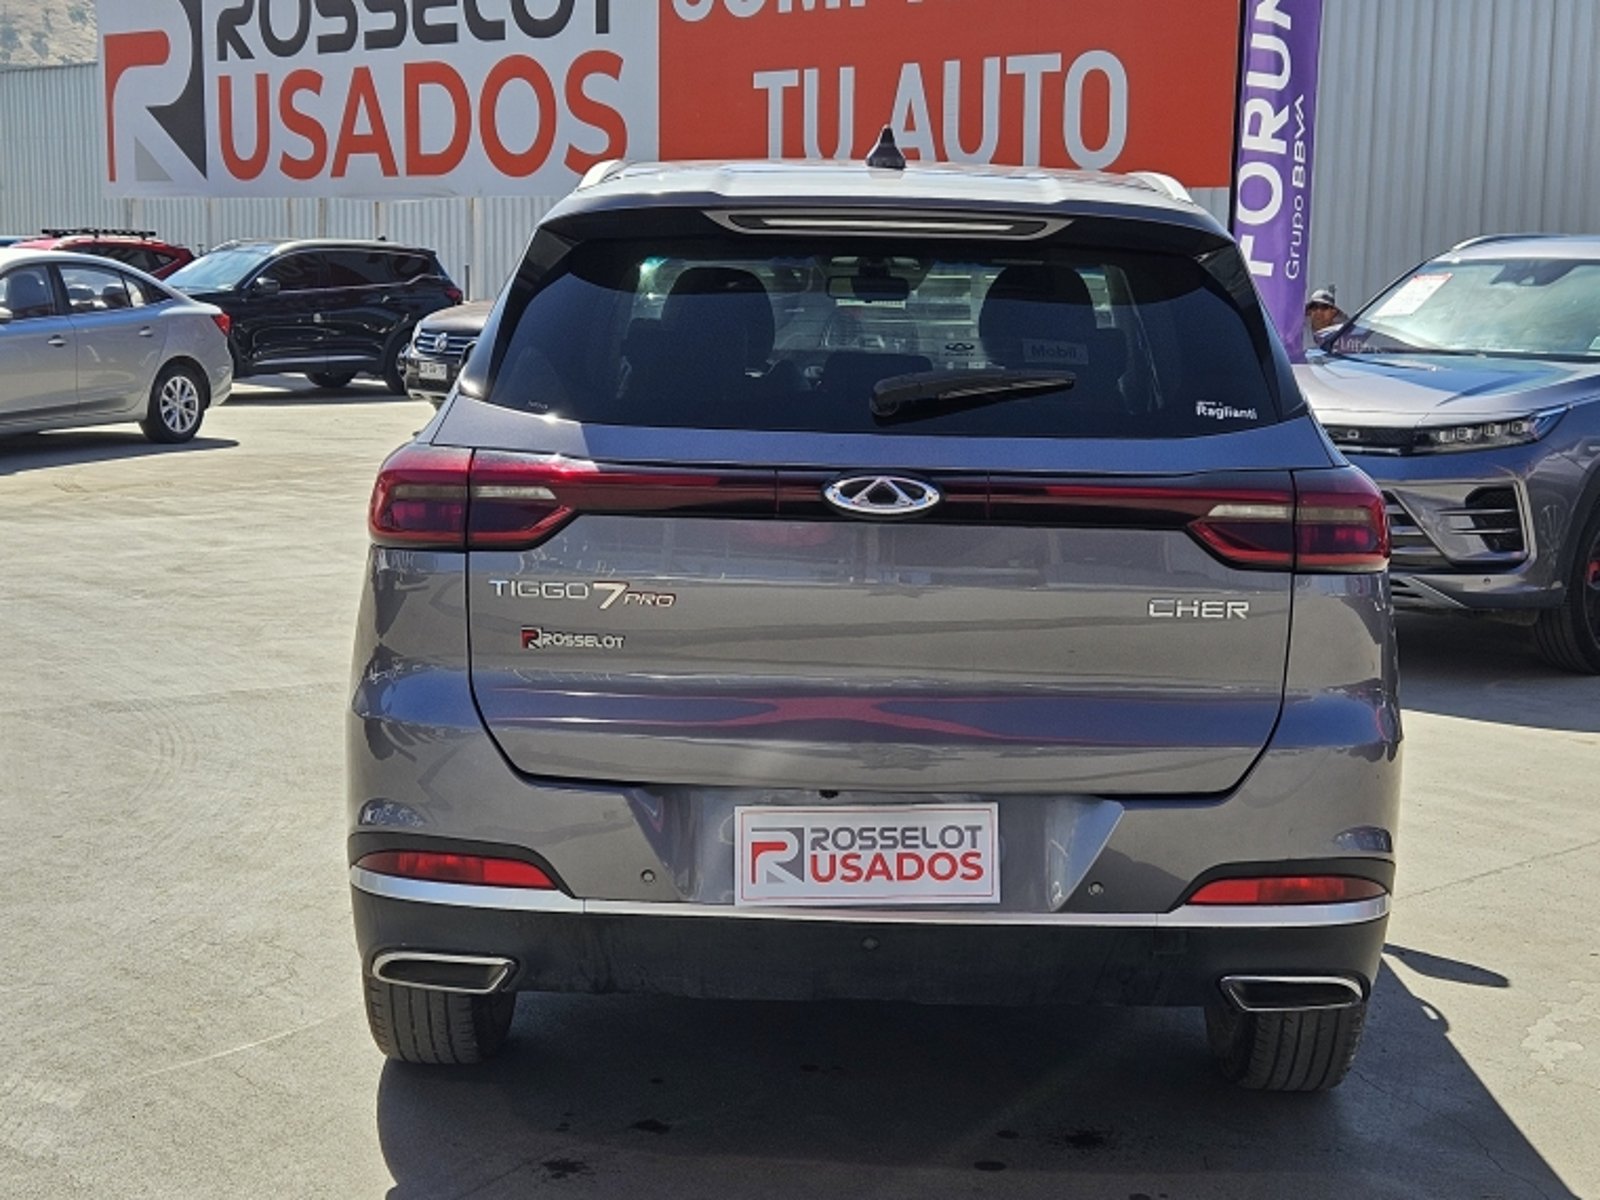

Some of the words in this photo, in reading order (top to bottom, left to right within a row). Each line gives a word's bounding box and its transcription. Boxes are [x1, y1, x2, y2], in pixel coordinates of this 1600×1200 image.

[218, 49, 628, 180] USADOS
[753, 67, 855, 161] TU
[889, 49, 1128, 170] AUTO
[1291, 94, 1306, 188] BBVA
[1285, 195, 1304, 279] Grupo
[488, 580, 589, 599] TIGGO
[592, 581, 629, 609] 7
[623, 592, 677, 608] PRO
[1148, 599, 1250, 619] CHER
[542, 632, 625, 649] ROSSELOT
[810, 825, 983, 850] ROSSELOT
[810, 852, 984, 882] USADOS
